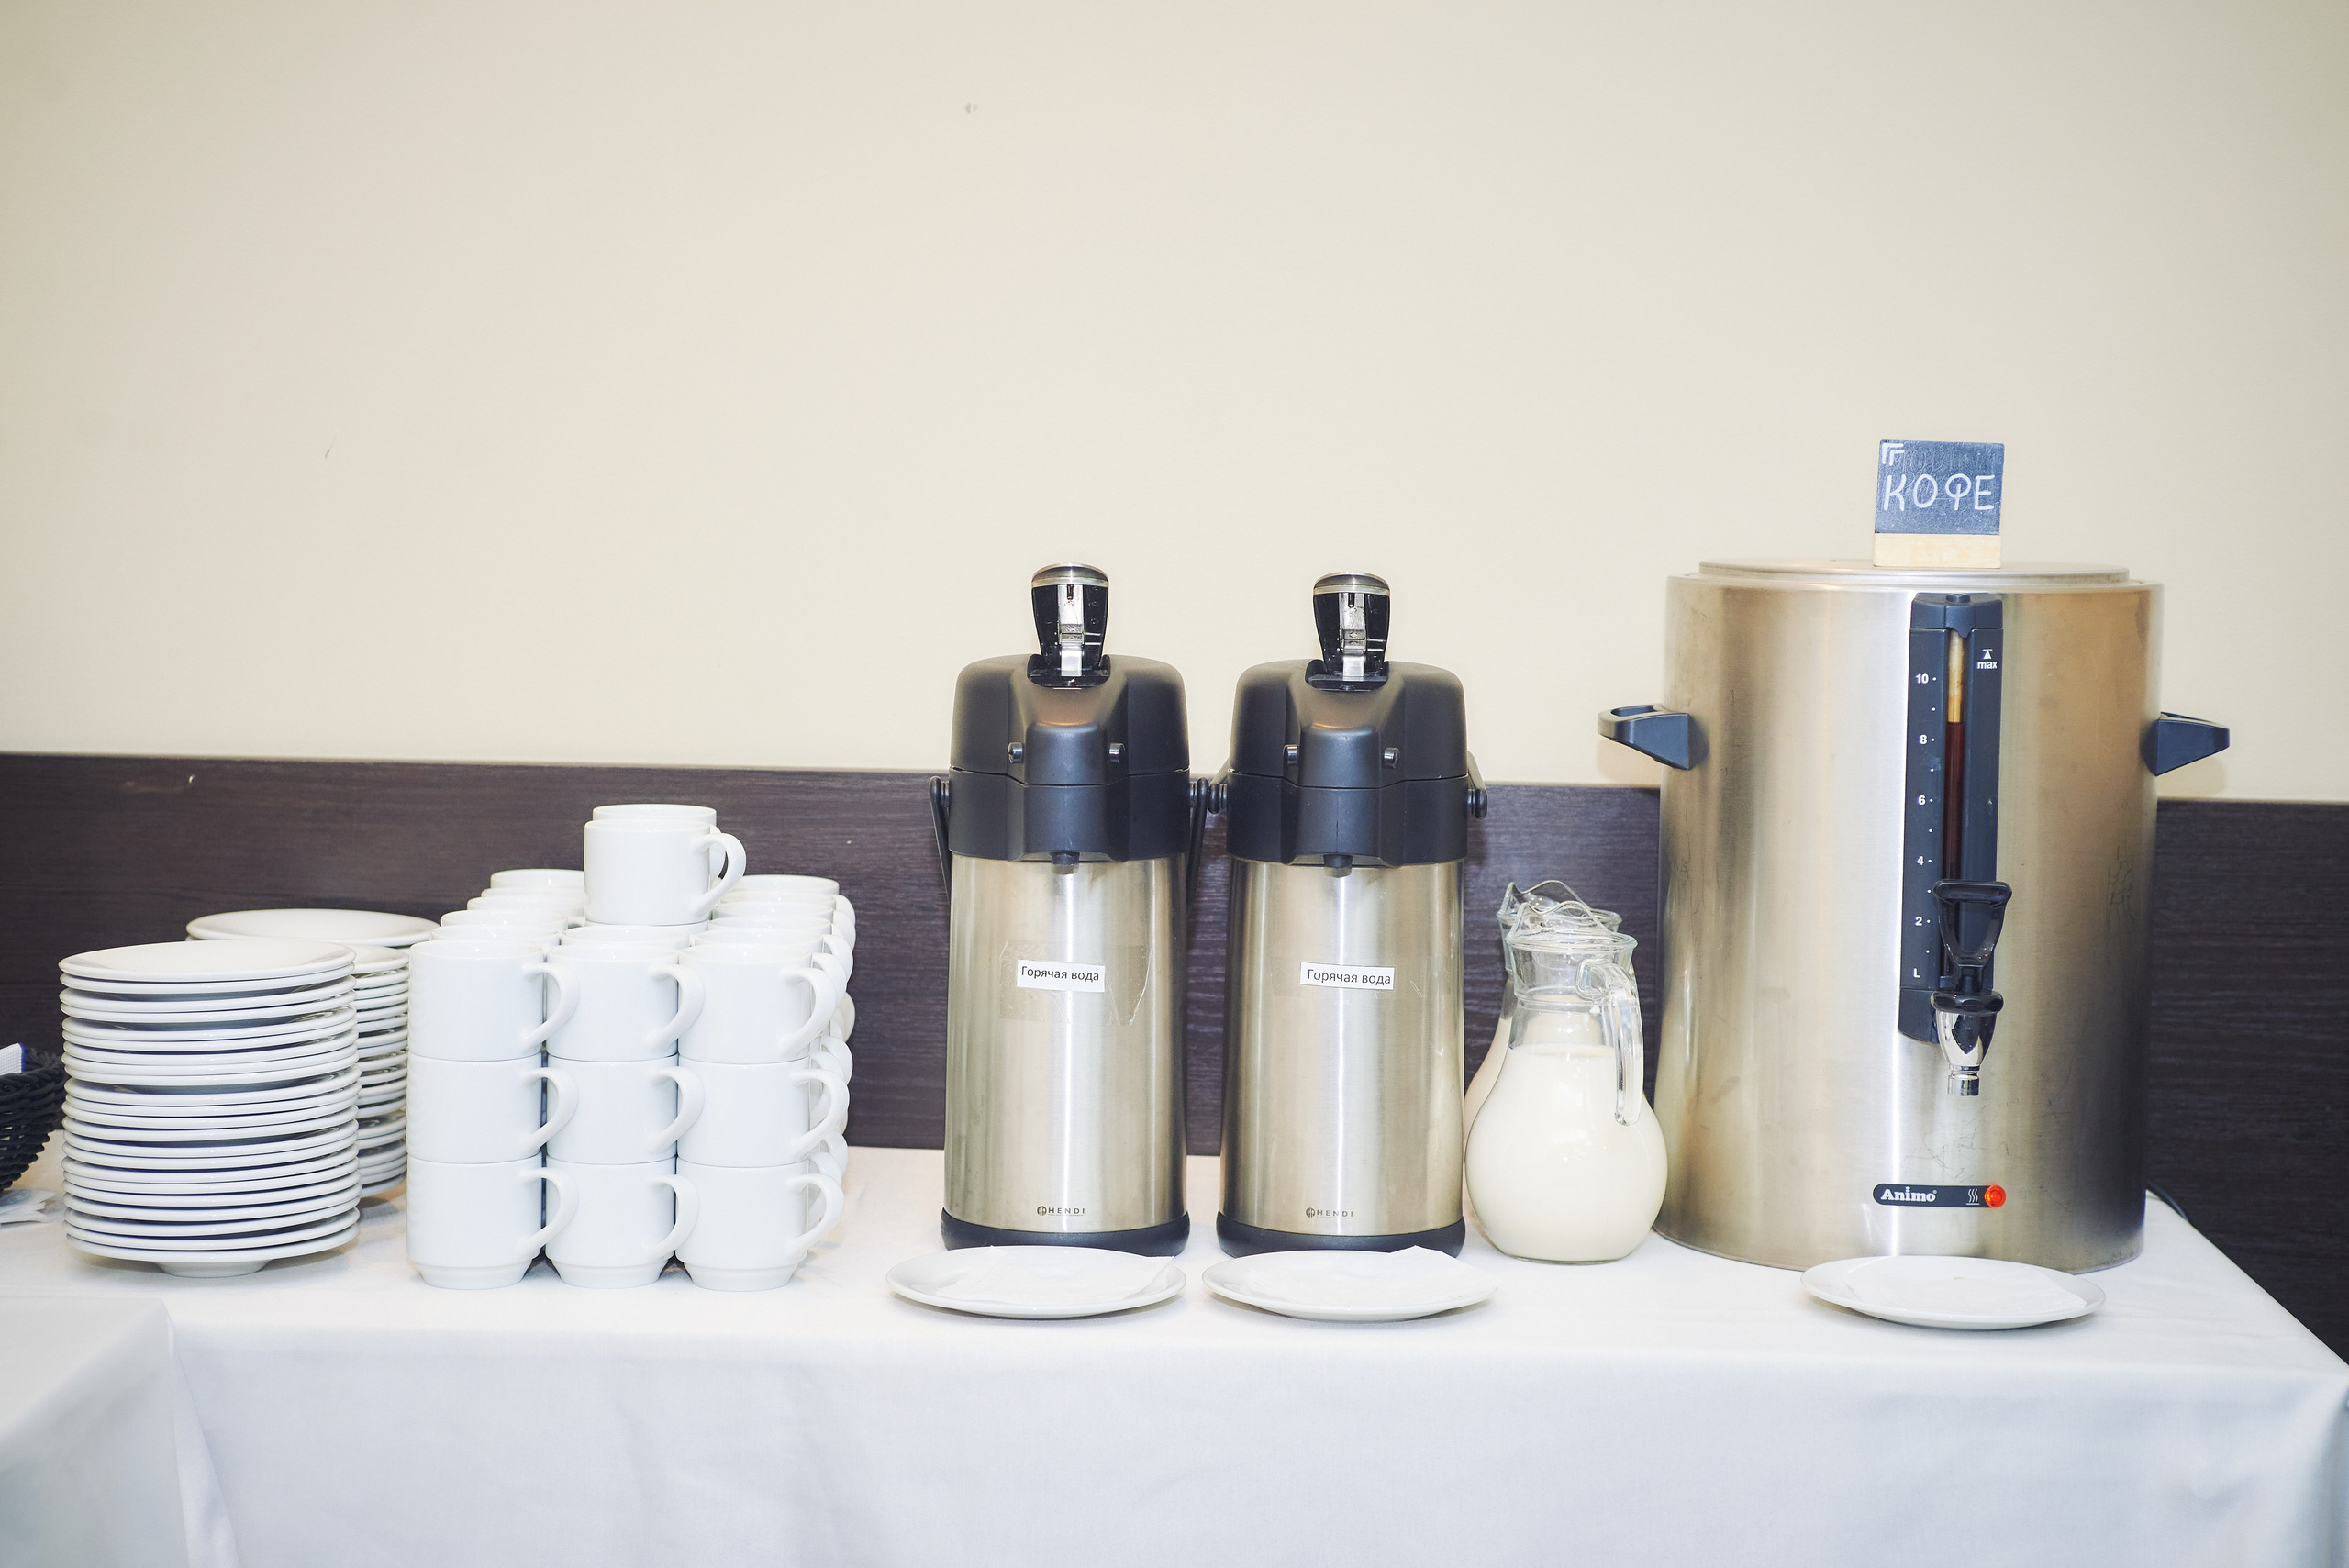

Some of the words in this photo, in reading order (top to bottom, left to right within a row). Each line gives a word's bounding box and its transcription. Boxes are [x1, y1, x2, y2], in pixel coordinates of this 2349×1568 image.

[1883, 473, 1996, 512] КОФЕ
[1976, 660, 1998, 670] max
[1915, 673, 1929, 684] 10
[1919, 735, 1928, 745] 8
[1918, 795, 1926, 806] 6
[1916, 856, 1924, 866] 4
[1915, 917, 1923, 927] 2
[1021, 965, 1068, 979] Горячая
[1071, 972, 1099, 983] вода
[1308, 969, 1358, 983] Горячая
[1362, 974, 1391, 986] вода
[1912, 968, 1920, 979] L
[1881, 1186, 1936, 1202] Animo
[1048, 1207, 1085, 1215] HENDI
[1316, 1209, 1353, 1218] HENDI
